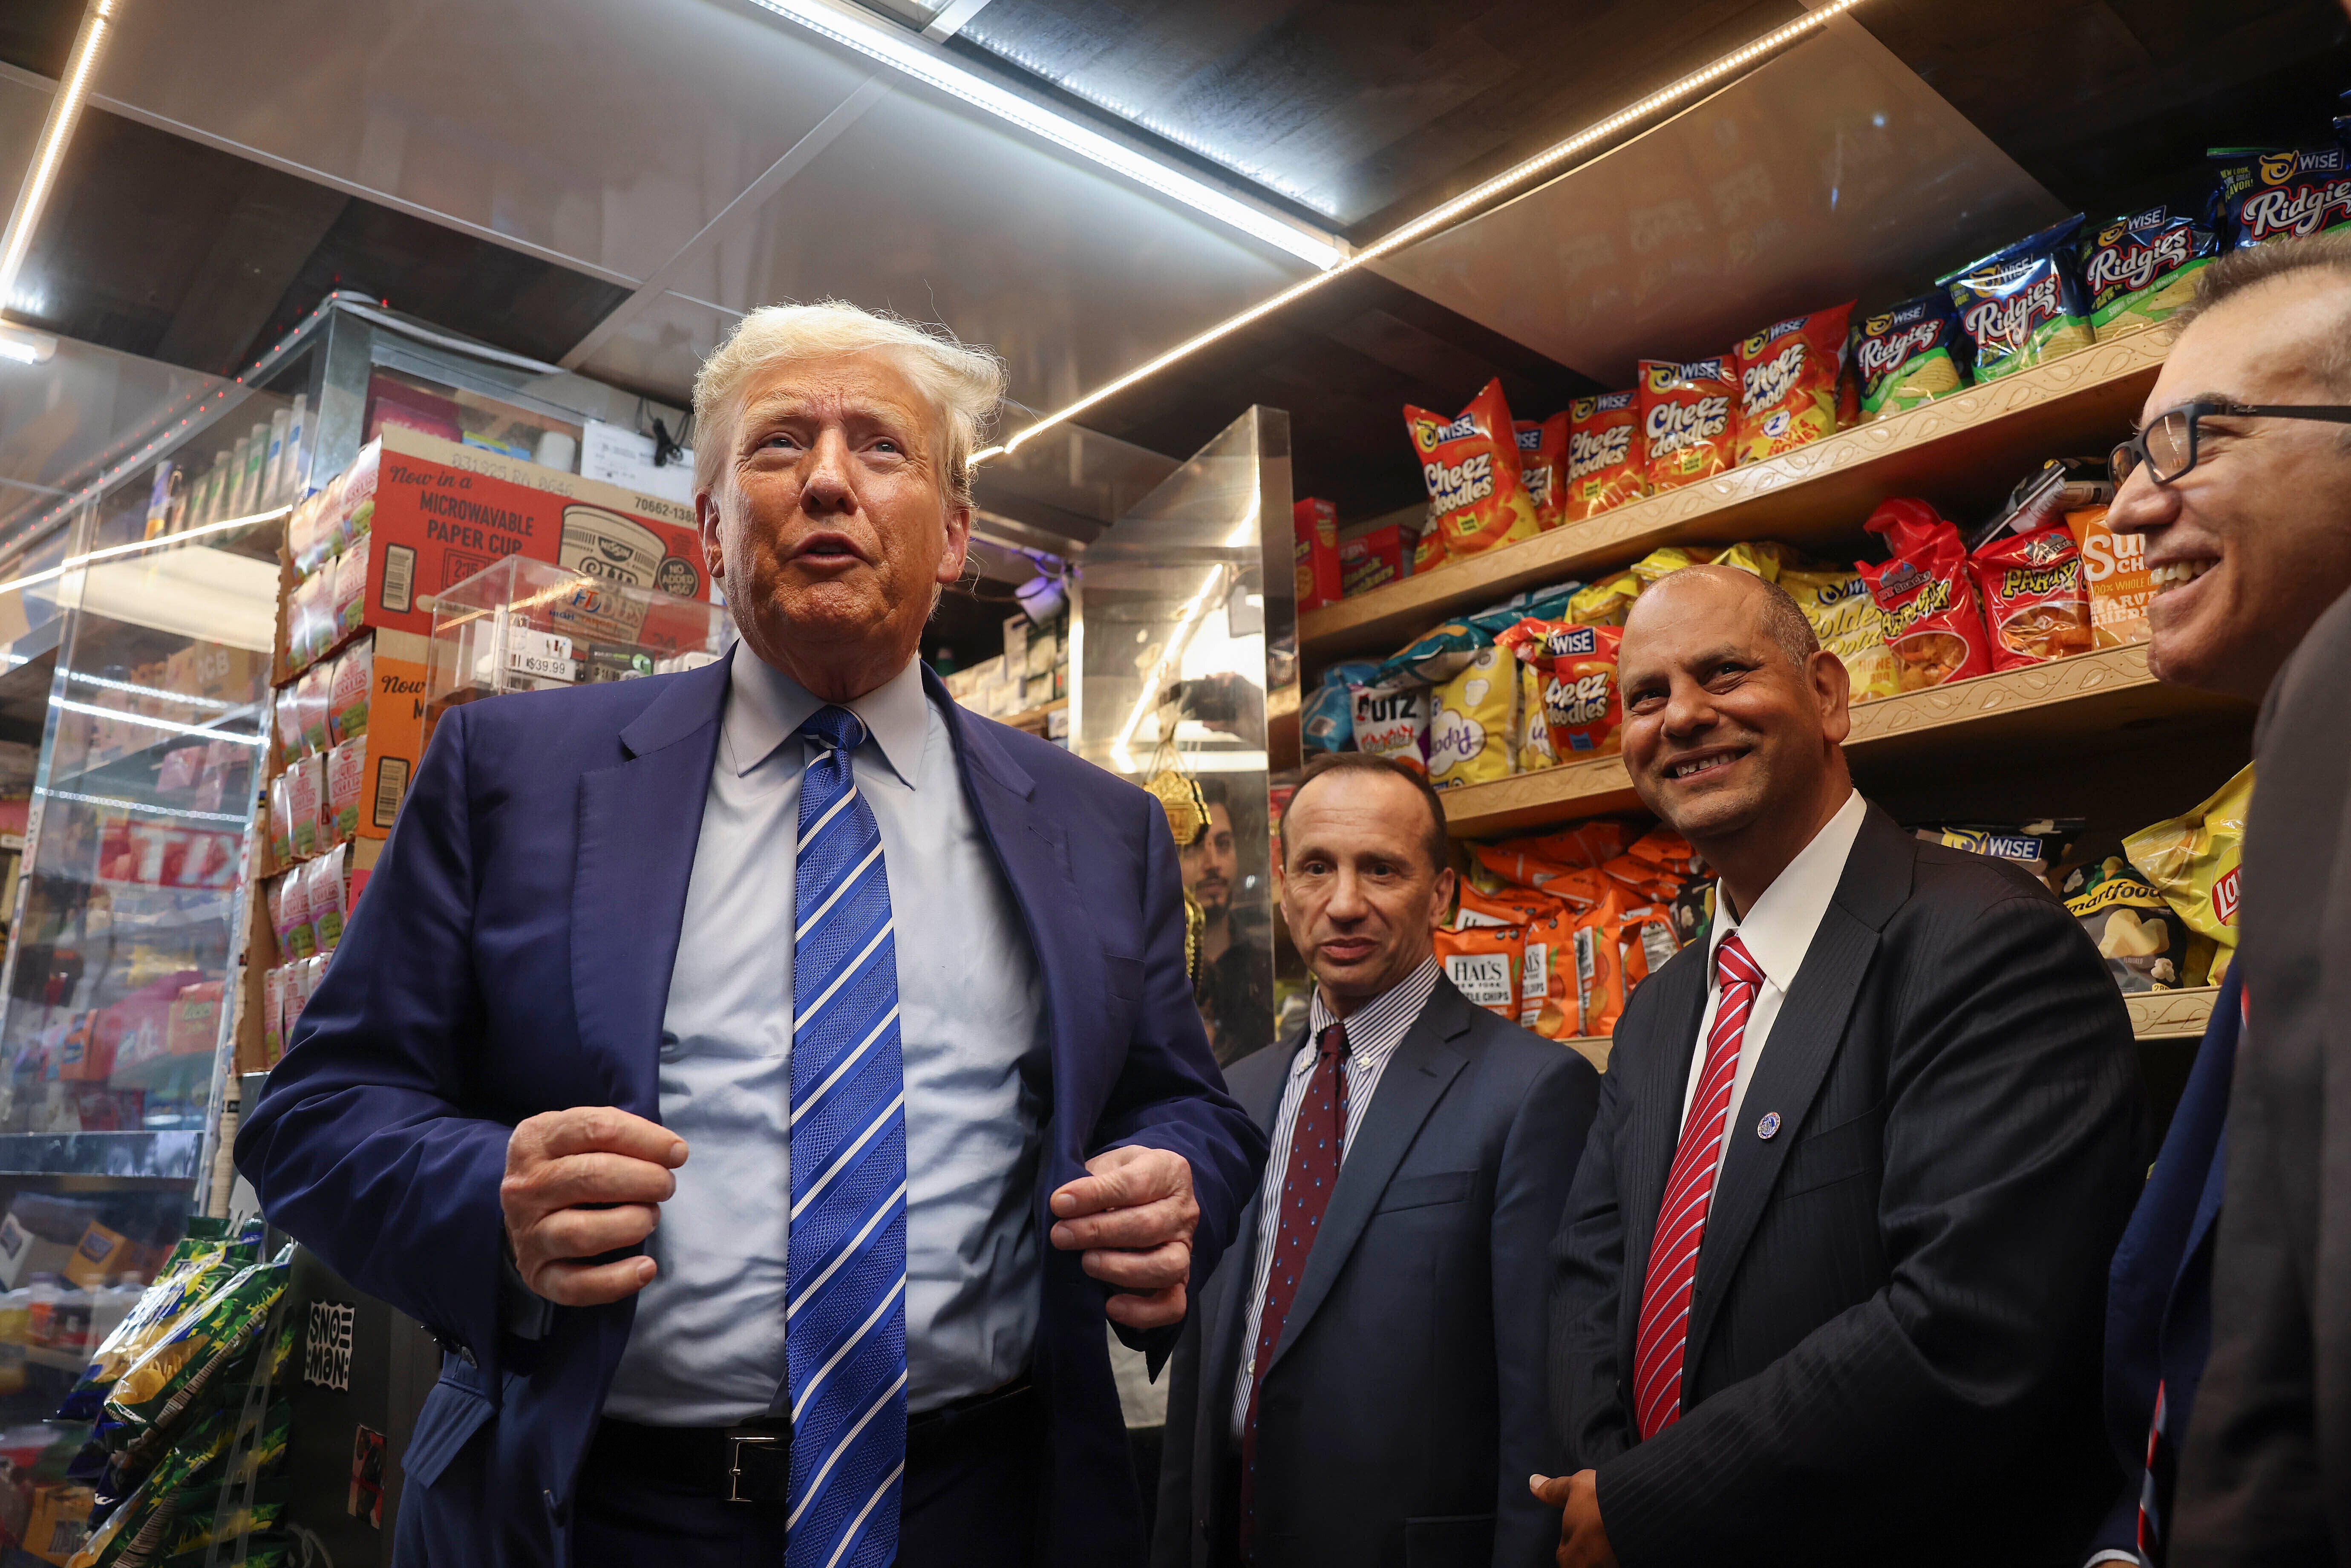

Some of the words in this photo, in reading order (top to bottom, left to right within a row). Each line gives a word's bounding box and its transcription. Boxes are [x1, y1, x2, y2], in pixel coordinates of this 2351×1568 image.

[2300, 152, 2338, 170] WISE
[2129, 209, 2161, 230] WISE
[2243, 182, 2351, 236] Ridgie
[2001, 258, 2030, 283] WISE
[2088, 228, 2188, 291] Ridgies
[2156, 273, 2179, 288] ONION
[1894, 307, 1922, 324] WISE
[1965, 277, 2057, 345] Ridgies
[1770, 317, 1805, 341] WISE
[1858, 320, 1939, 378] Ridgies
[1681, 362, 1717, 380] WISE
[1743, 343, 1806, 405] Cheez
[1598, 394, 1631, 410] WISE
[1438, 416, 1475, 441] WISE
[1646, 396, 1730, 439] Cheez
[1518, 431, 1539, 448] ISE
[1568, 425, 1634, 467] Cheez
[1650, 416, 1726, 459] doodles
[389, 466, 432, 484] Now
[436, 471, 455, 488] in
[459, 476, 473, 489] a
[1424, 453, 1492, 496] Cheez
[420, 490, 534, 537] MICROWAVABLE
[427, 519, 484, 550] PAPER
[488, 534, 523, 554] CUP
[1896, 571, 1930, 593] Snacks
[2002, 560, 2078, 597] PARTY
[2115, 577, 2144, 591] WHOLE
[1555, 631, 1592, 655] WISE
[528, 657, 566, 674] $39.99
[382, 674, 426, 695] Now
[1371, 693, 1417, 722] UTZ
[1989, 837, 2035, 858] WISE
[2066, 881, 2161, 912] martfoo
[1455, 960, 1502, 981] HAL'S
[1483, 992, 1509, 1001] CHIPS
